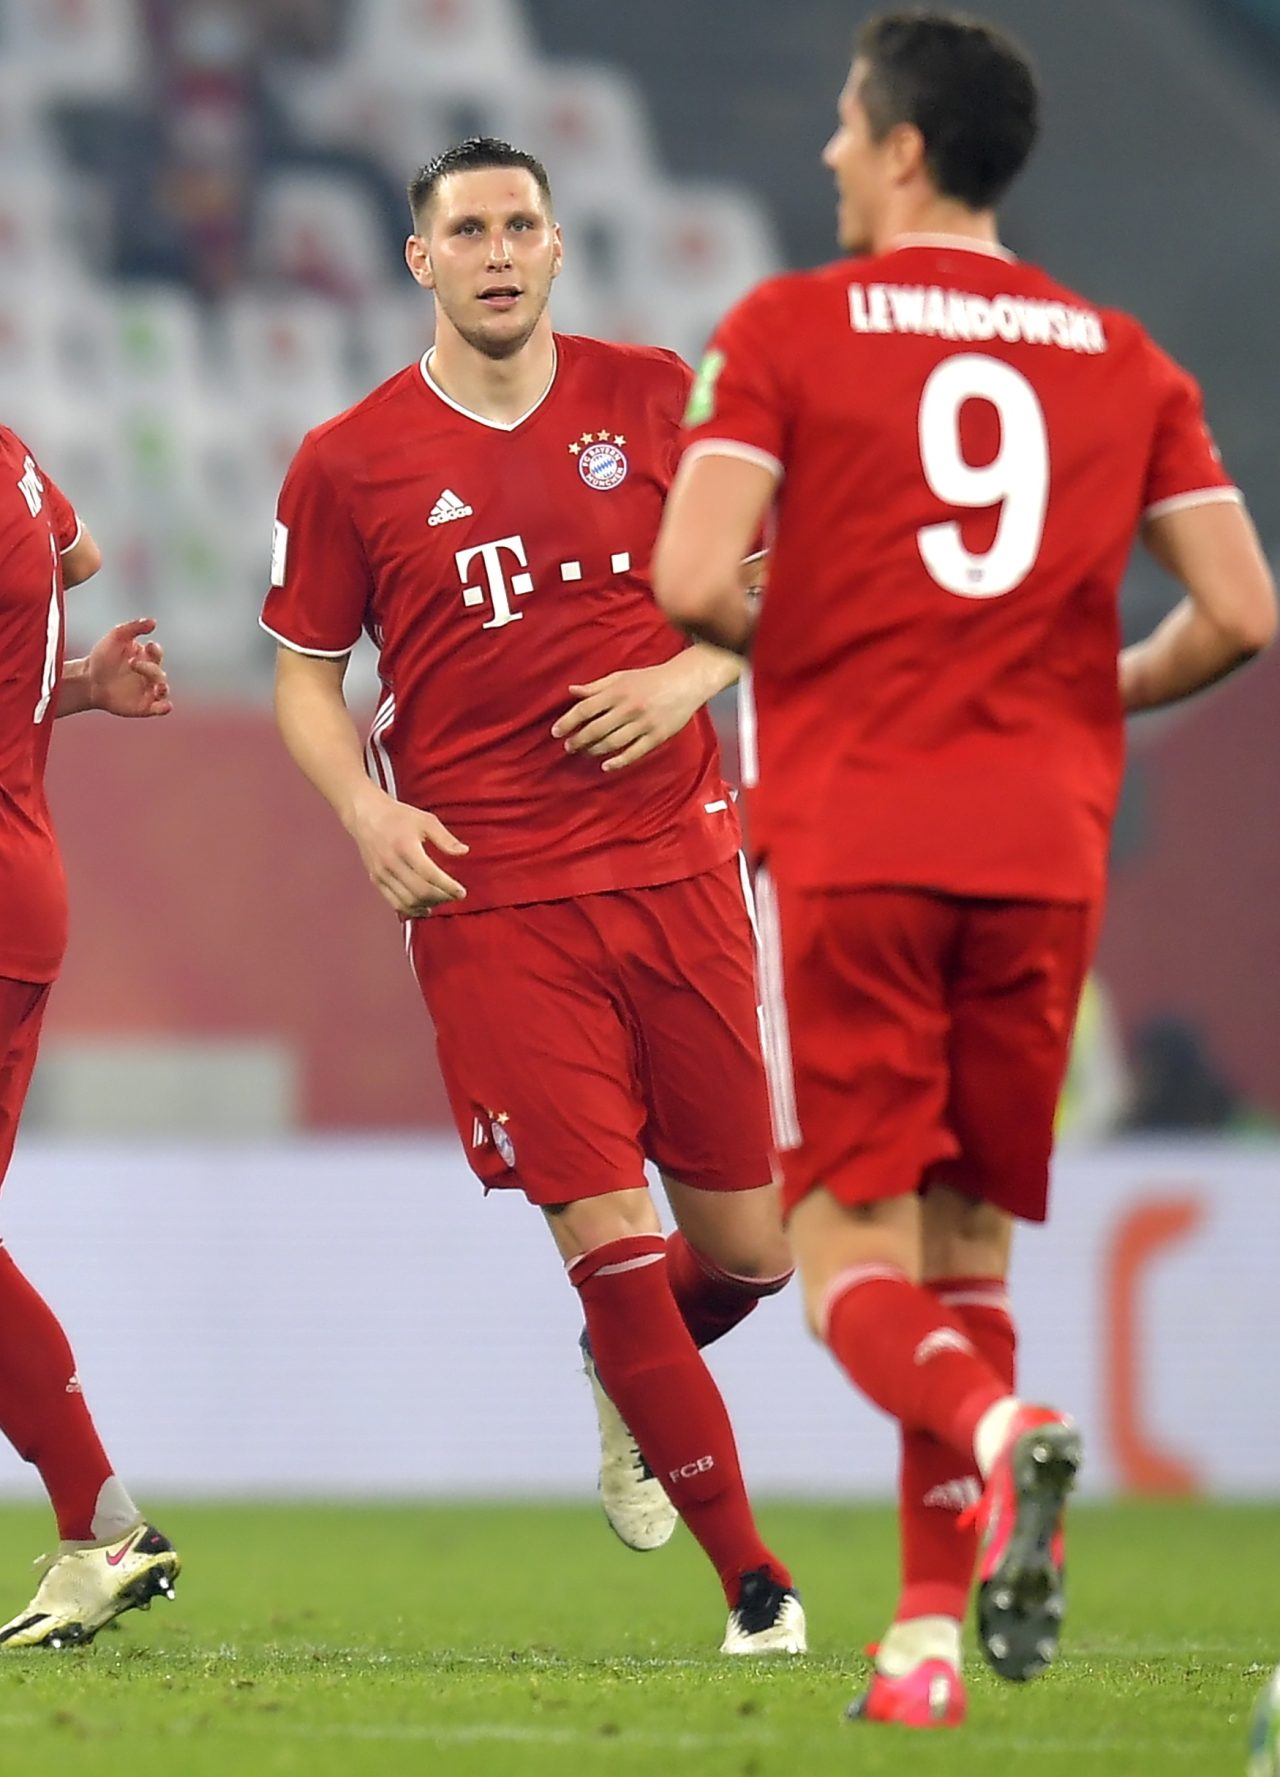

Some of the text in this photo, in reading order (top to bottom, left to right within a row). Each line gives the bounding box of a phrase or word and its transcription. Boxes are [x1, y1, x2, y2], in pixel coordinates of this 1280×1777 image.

[847, 282, 1108, 354] LEWANDOWSKI
[918, 352, 1050, 599] 9
[427, 505, 474, 527] adidas
[669, 1455, 714, 1483] FCB
